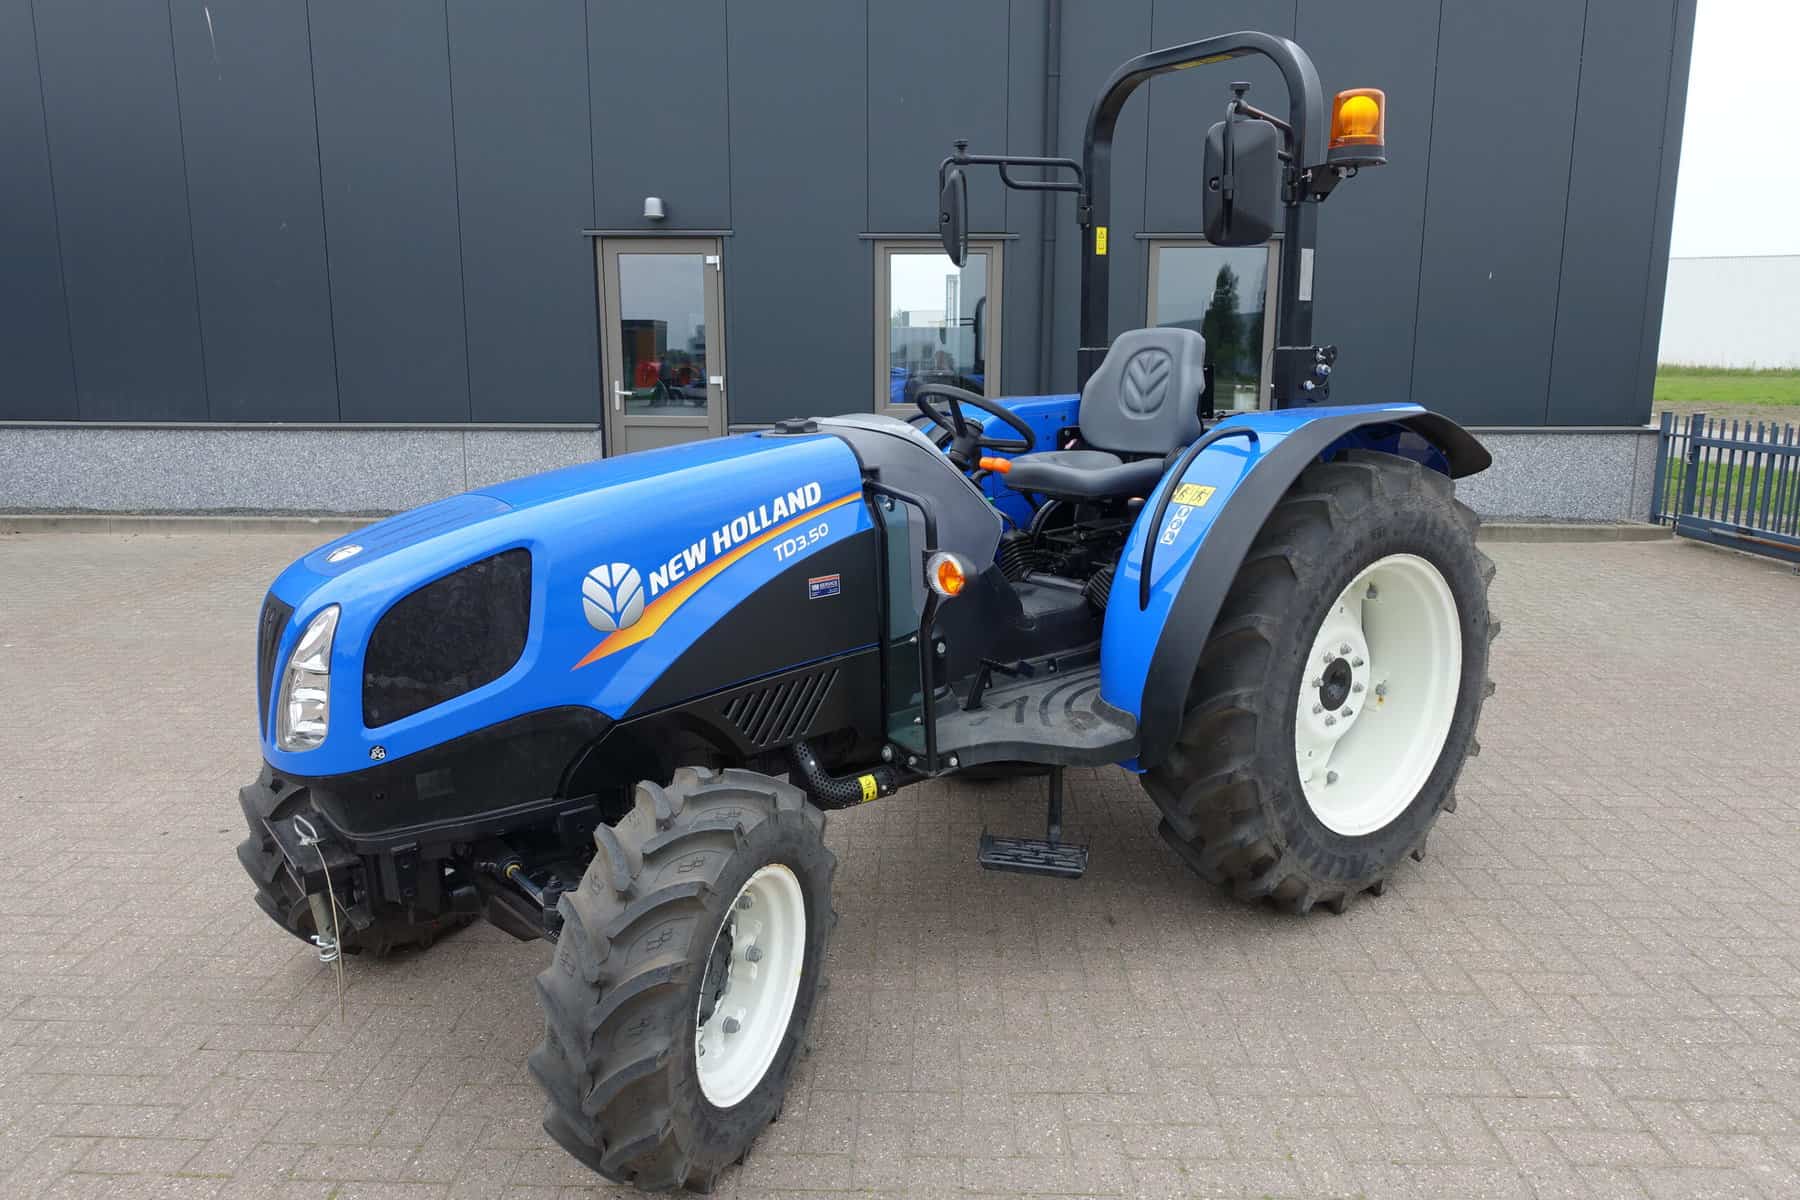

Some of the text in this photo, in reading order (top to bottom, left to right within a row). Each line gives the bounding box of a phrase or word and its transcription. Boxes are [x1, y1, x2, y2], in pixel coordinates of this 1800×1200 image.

[649, 481, 822, 596] NEW HOLLAND
[773, 522, 829, 562] TD3.50
